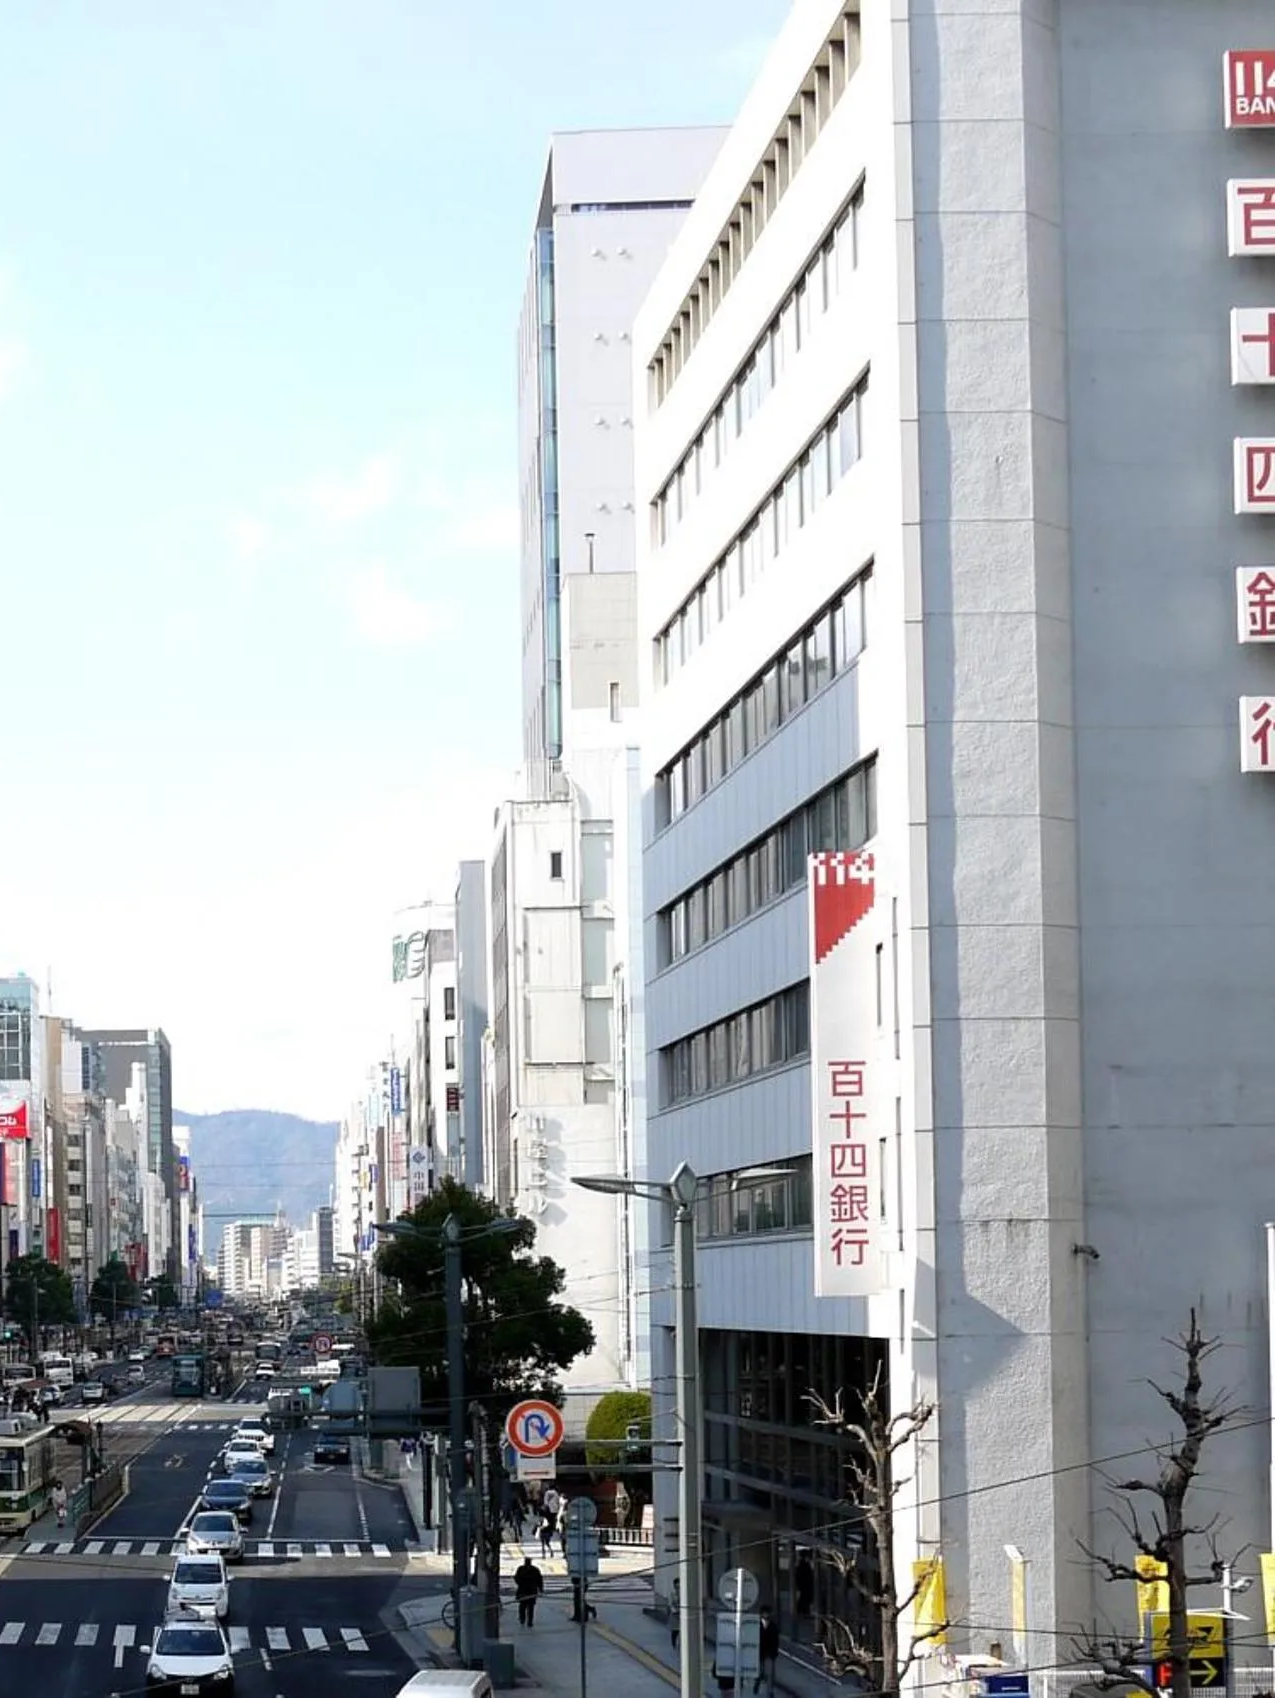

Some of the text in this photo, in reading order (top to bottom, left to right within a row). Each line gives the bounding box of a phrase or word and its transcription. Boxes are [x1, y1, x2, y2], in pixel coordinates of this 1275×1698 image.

[827, 1060, 869, 1266] 百十四銀行
